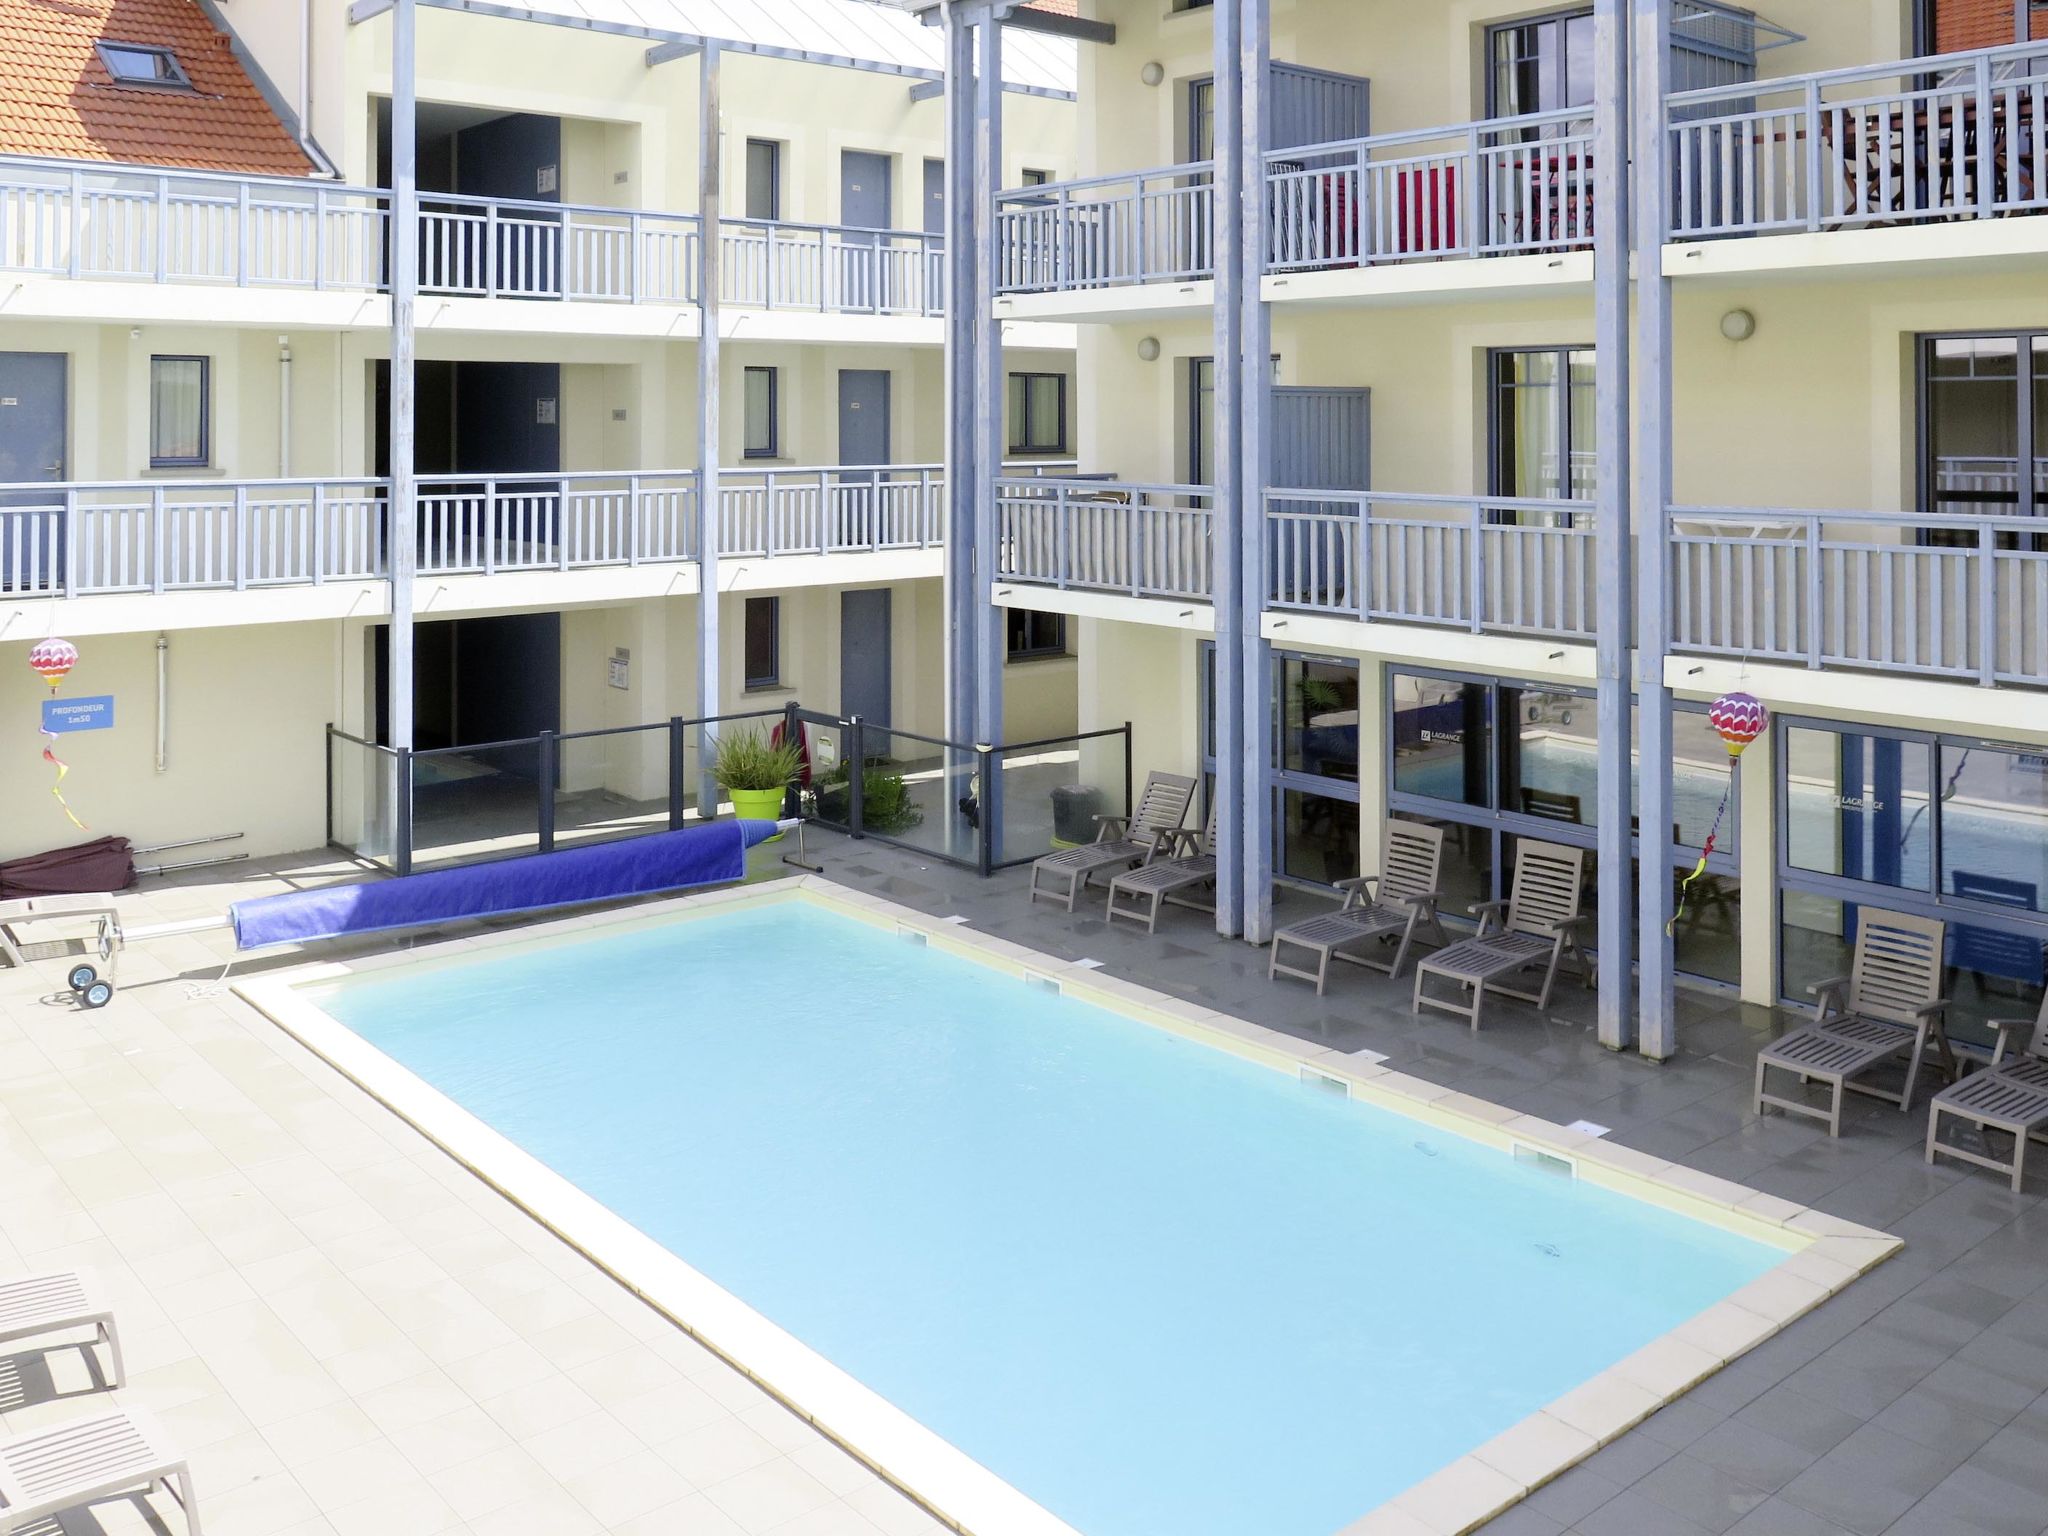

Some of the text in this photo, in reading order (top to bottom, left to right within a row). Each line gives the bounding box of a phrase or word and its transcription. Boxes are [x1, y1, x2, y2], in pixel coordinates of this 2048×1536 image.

[52, 703, 104, 715] PROFONDEUR
[1431, 731, 1461, 741] LAGRANGE
[1842, 797, 1884, 810] LAGRGE
